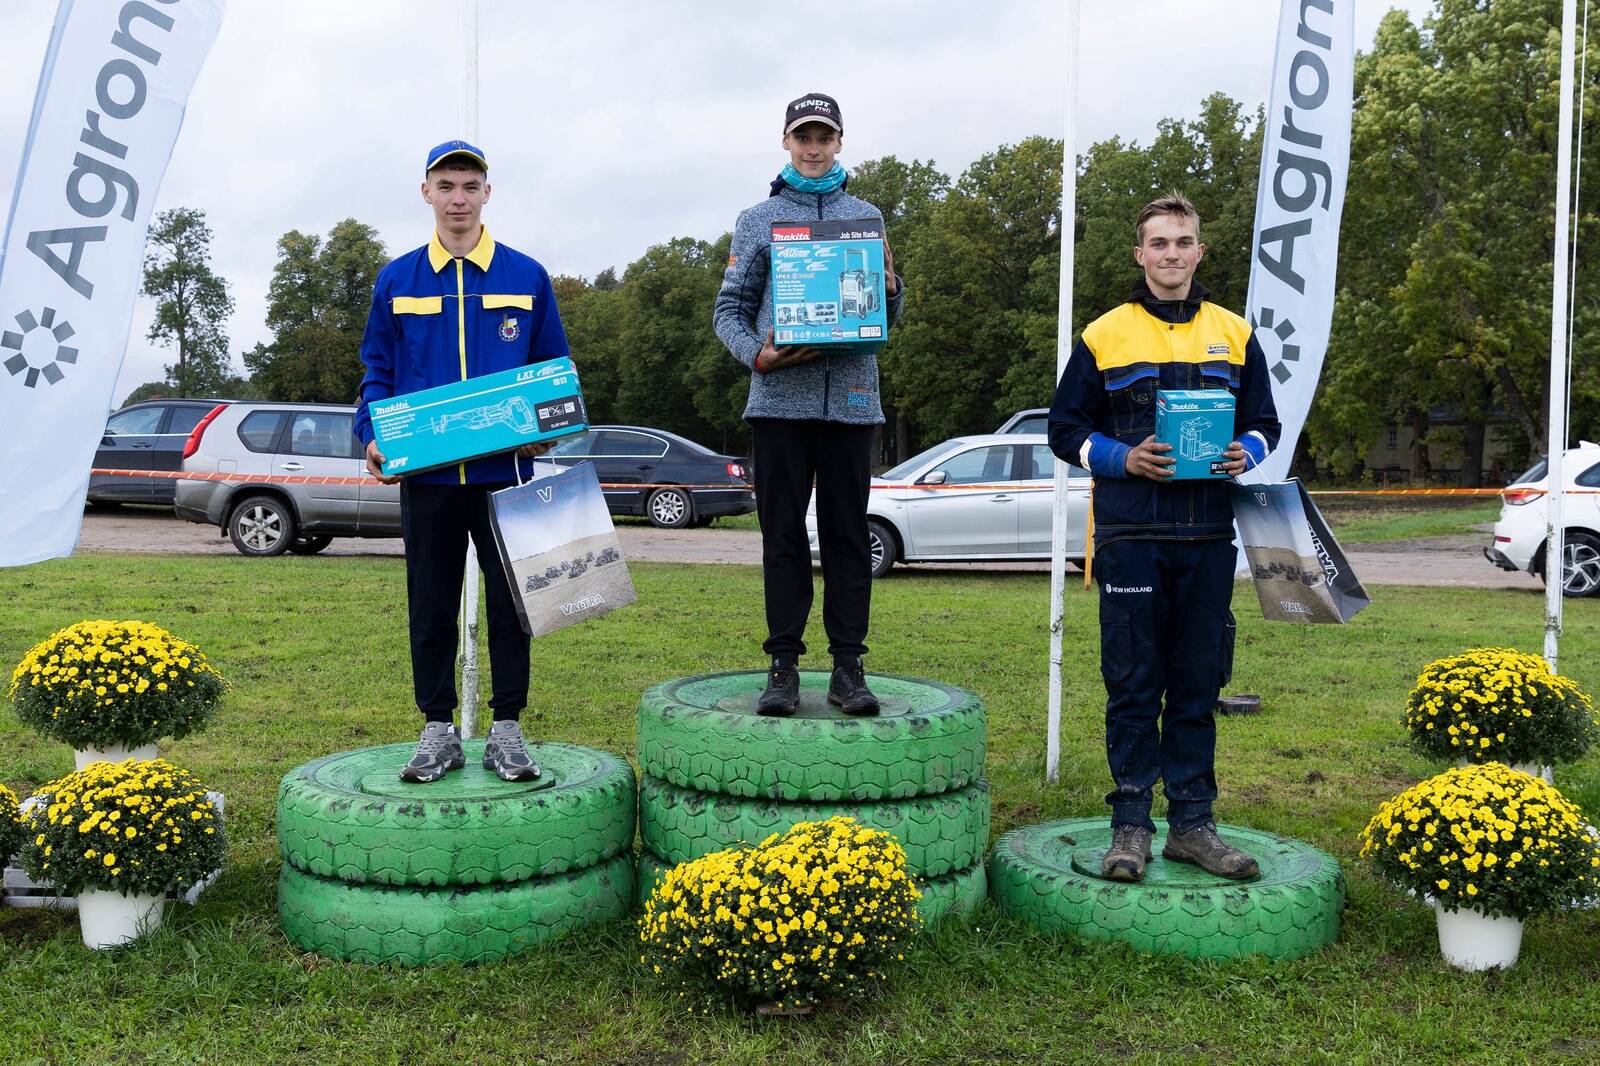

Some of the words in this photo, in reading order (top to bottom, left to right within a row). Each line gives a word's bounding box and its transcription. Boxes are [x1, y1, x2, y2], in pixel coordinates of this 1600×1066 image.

[794, 99, 831, 111] FENDT
[814, 105, 831, 114] Profi
[26, 0, 181, 300] Agron
[839, 231, 850, 239] Job
[850, 231, 862, 239] Site
[863, 230, 879, 238] Radio
[516, 369, 535, 382] LXT
[387, 456, 408, 470] XPT
[536, 485, 552, 503] V
[1254, 492, 1267, 506] V
[560, 593, 605, 616] VALTRA
